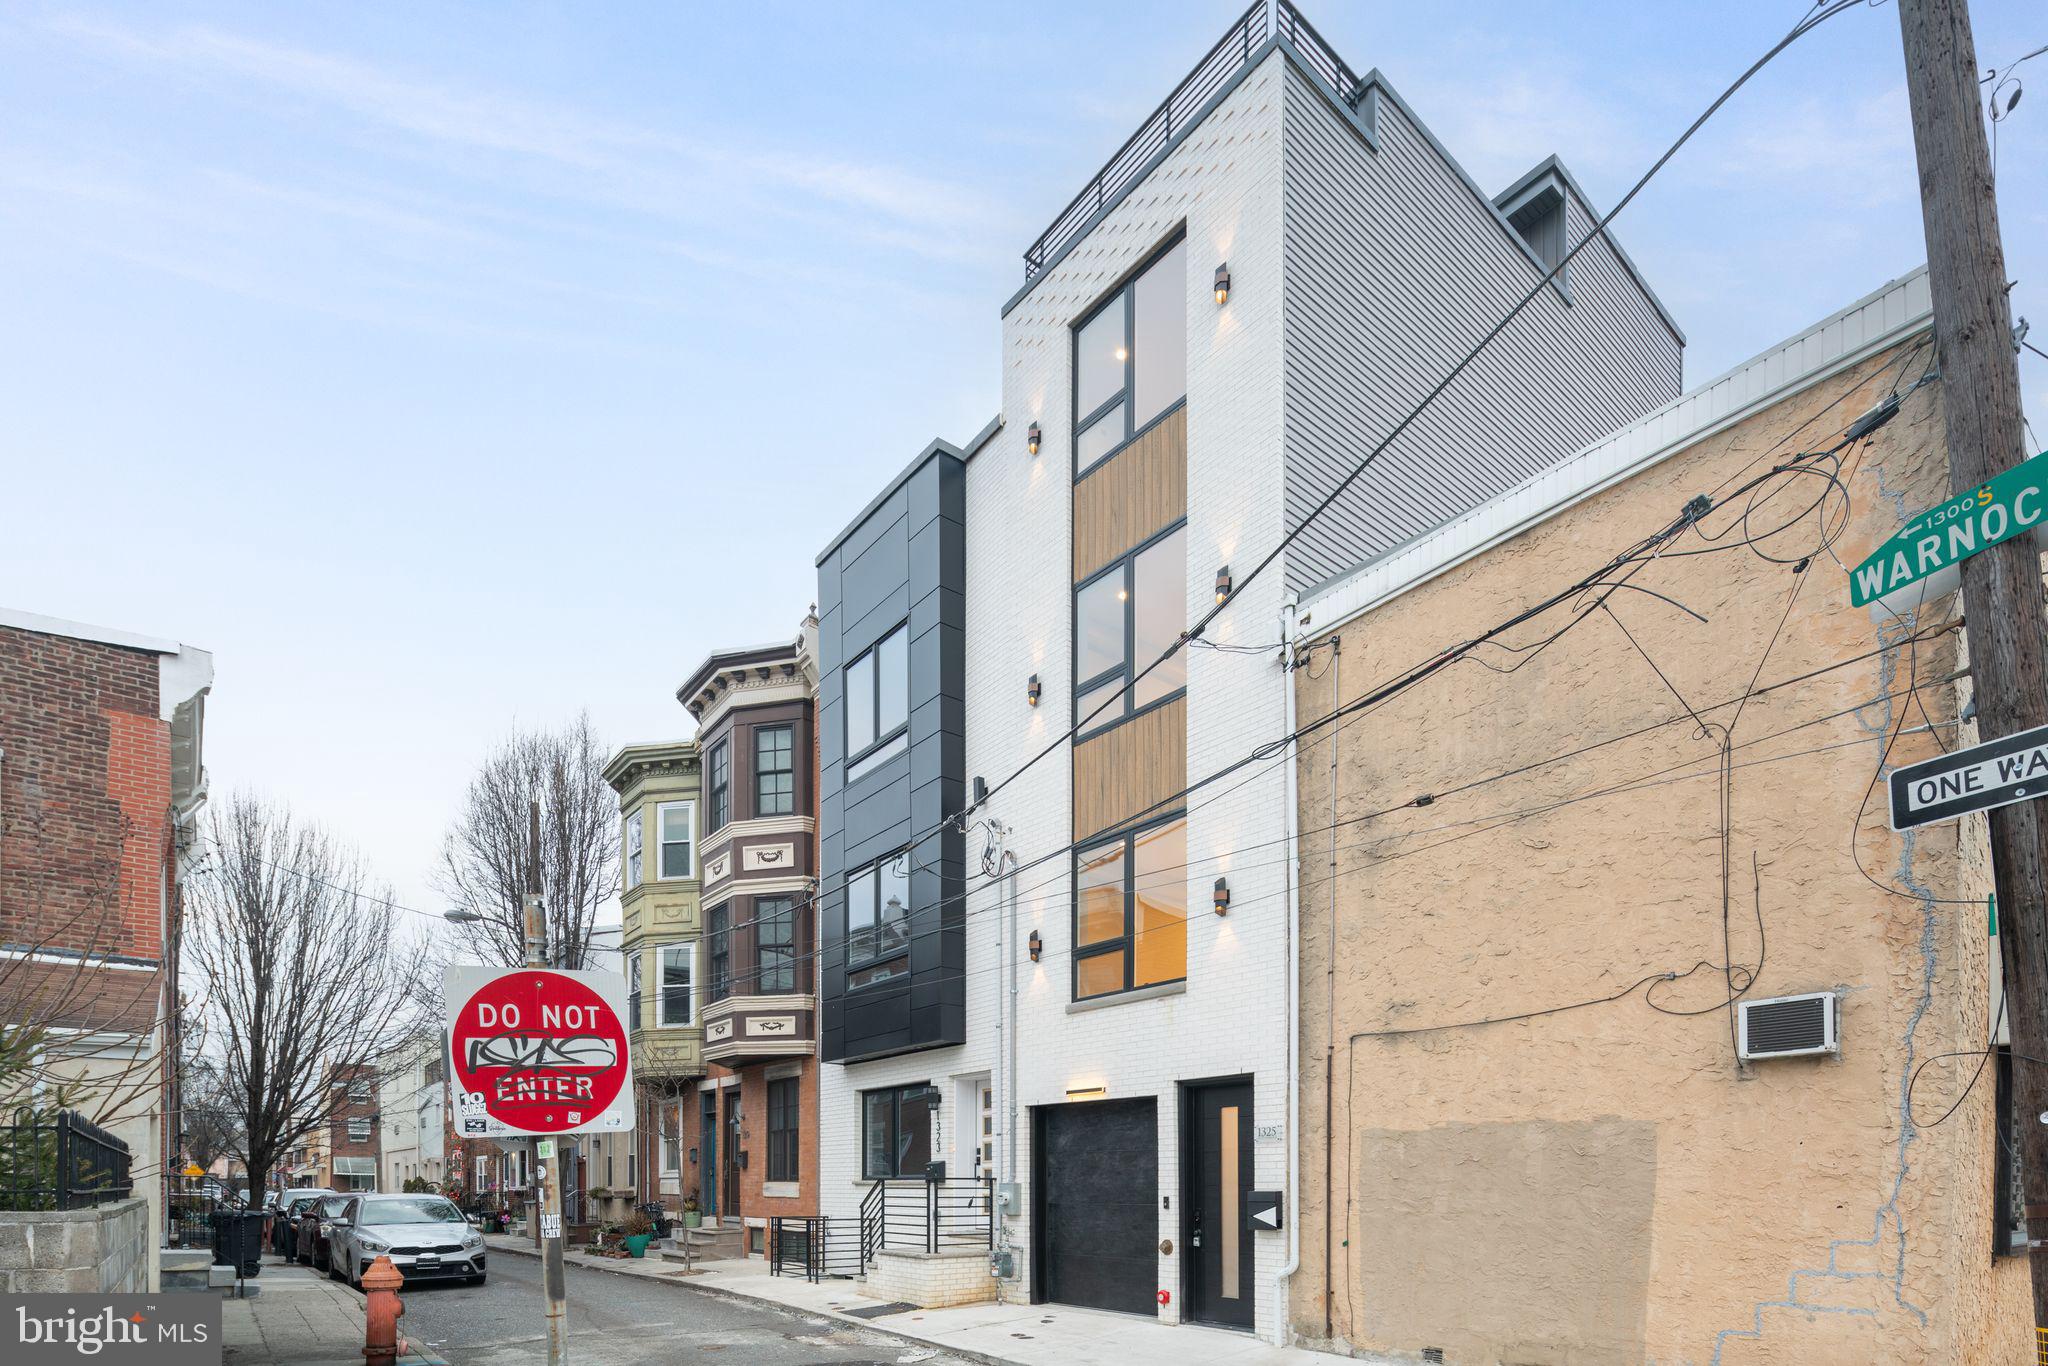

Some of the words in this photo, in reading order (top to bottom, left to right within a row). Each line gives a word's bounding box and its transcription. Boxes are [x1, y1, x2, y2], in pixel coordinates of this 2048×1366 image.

[1925, 497, 1974, 529] 1300
[1977, 486, 1993, 507] S
[1856, 480, 2048, 601] WARNOC
[1917, 766, 1985, 804] ONE
[1997, 747, 2048, 783] WA
[478, 1003, 521, 1029] DO
[542, 1004, 600, 1030] NOT
[460, 1092, 485, 1105] 10
[496, 1076, 595, 1102] ENTER
[1257, 1126, 1277, 1137] 1325
